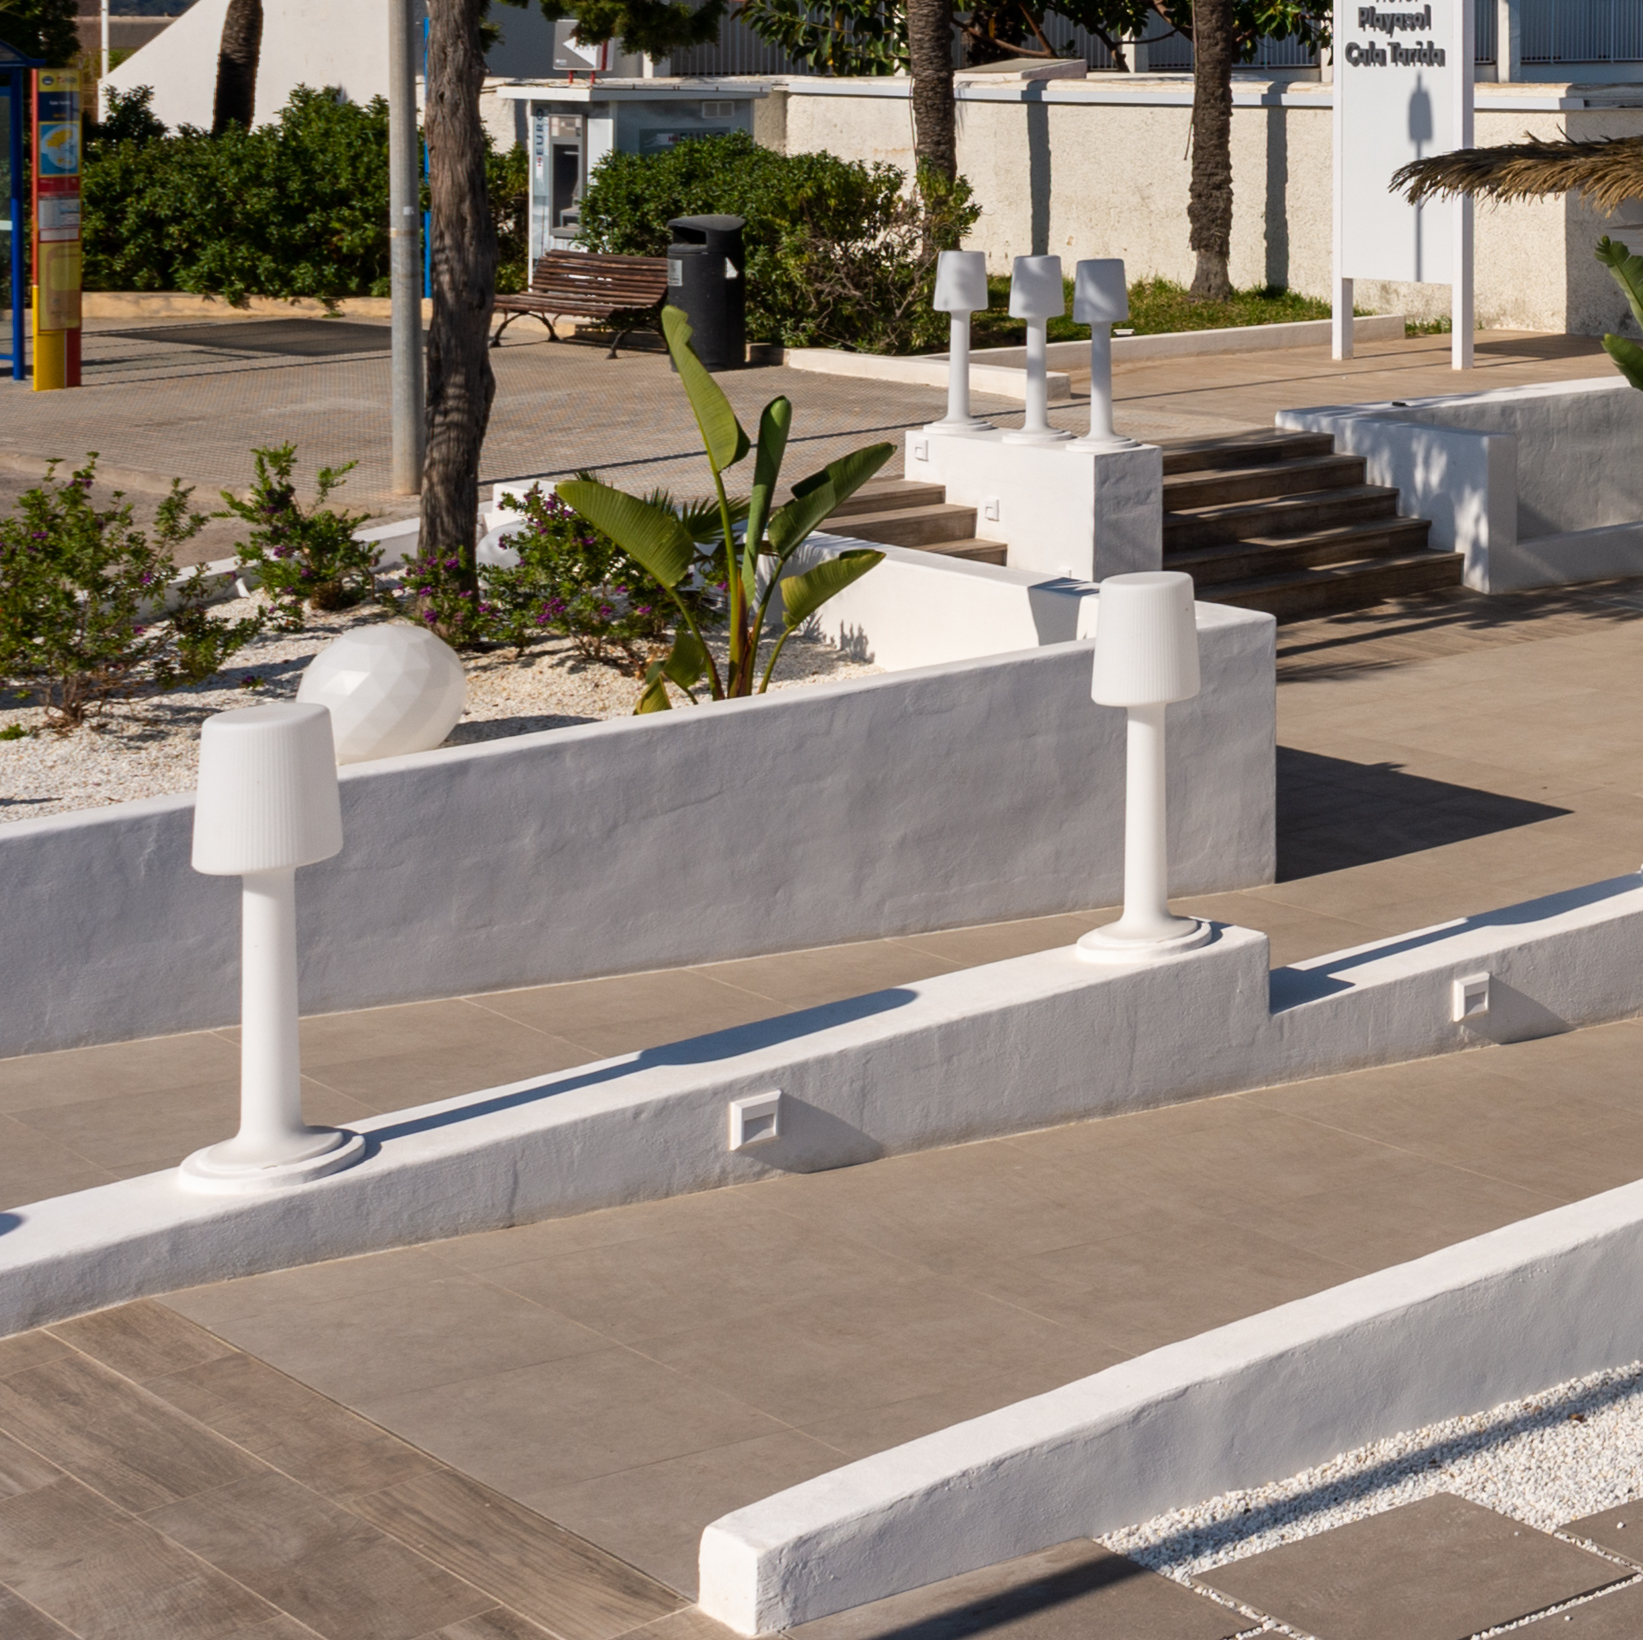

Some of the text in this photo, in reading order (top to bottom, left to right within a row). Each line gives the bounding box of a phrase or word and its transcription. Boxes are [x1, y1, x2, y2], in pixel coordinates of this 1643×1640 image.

[1358, 4, 1432, 37] Playasol
[1345, 41, 1446, 67] Cala Tarida
